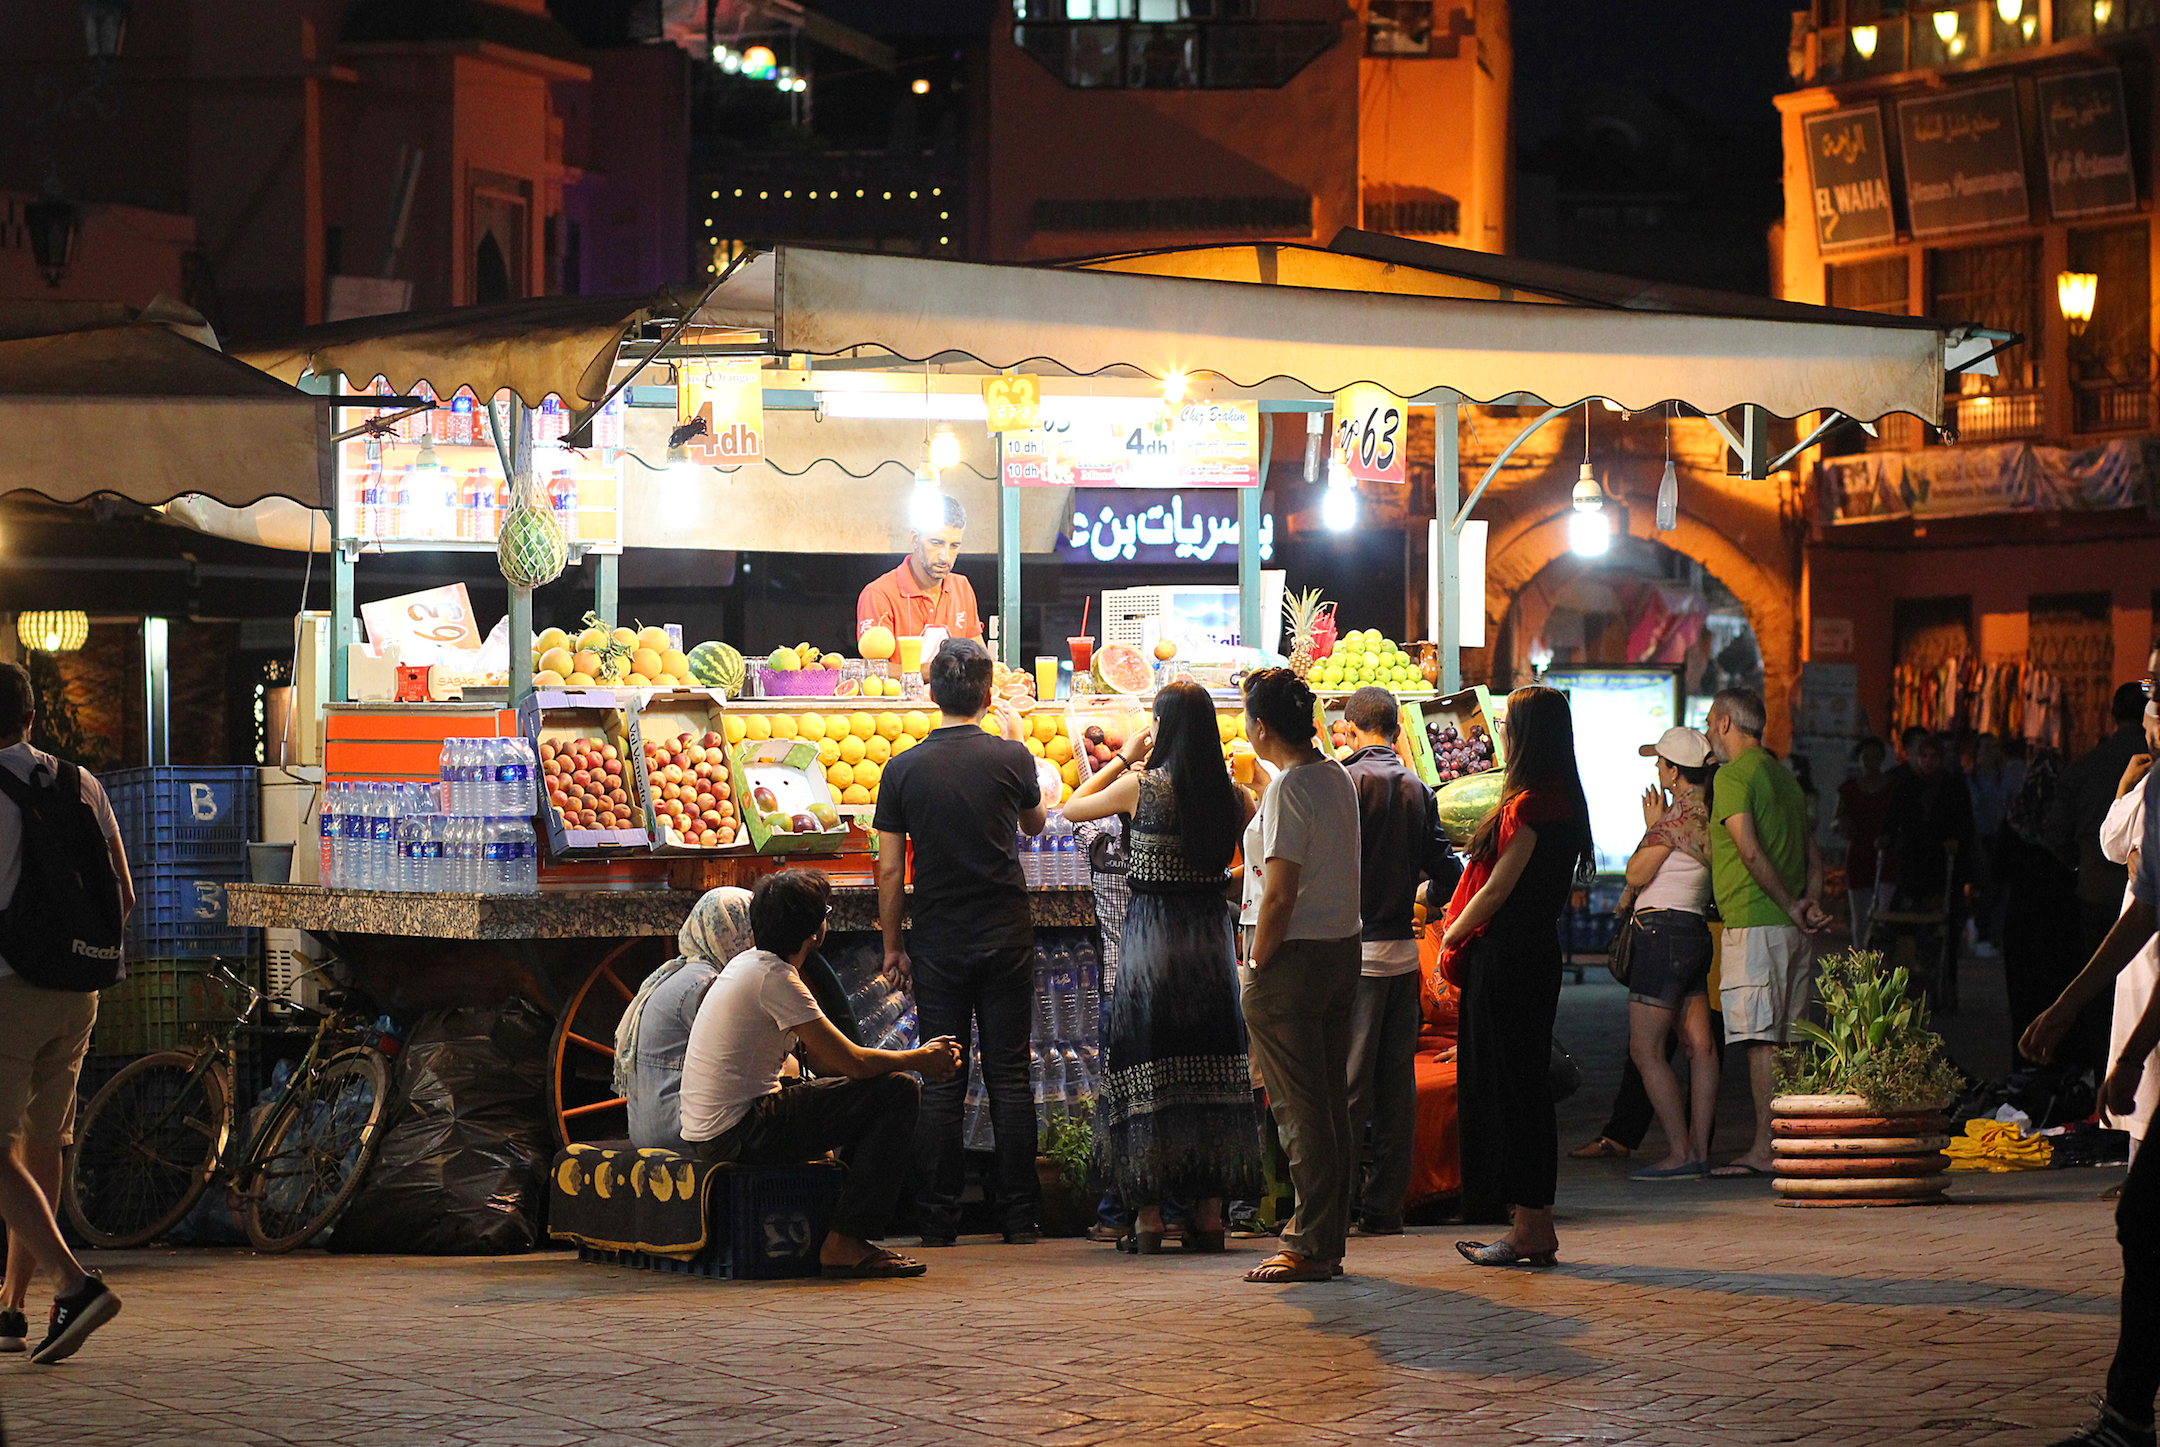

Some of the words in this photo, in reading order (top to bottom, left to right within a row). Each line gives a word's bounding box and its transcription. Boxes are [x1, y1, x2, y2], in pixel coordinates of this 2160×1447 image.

[1818, 187, 1835, 219] EL
[1836, 179, 1888, 213] WAHA
[988, 379, 1037, 427] 63
[1209, 406, 1246, 422] Brahim
[1008, 440, 1021, 453] 10
[1024, 440, 1037, 453] dh
[1008, 464, 1021, 476] 10
[1024, 464, 1038, 476] dh
[437, 676, 477, 687] SABAR
[629, 723, 638, 742] Val
[632, 746, 646, 804] Venosta
[189, 782, 218, 821] B
